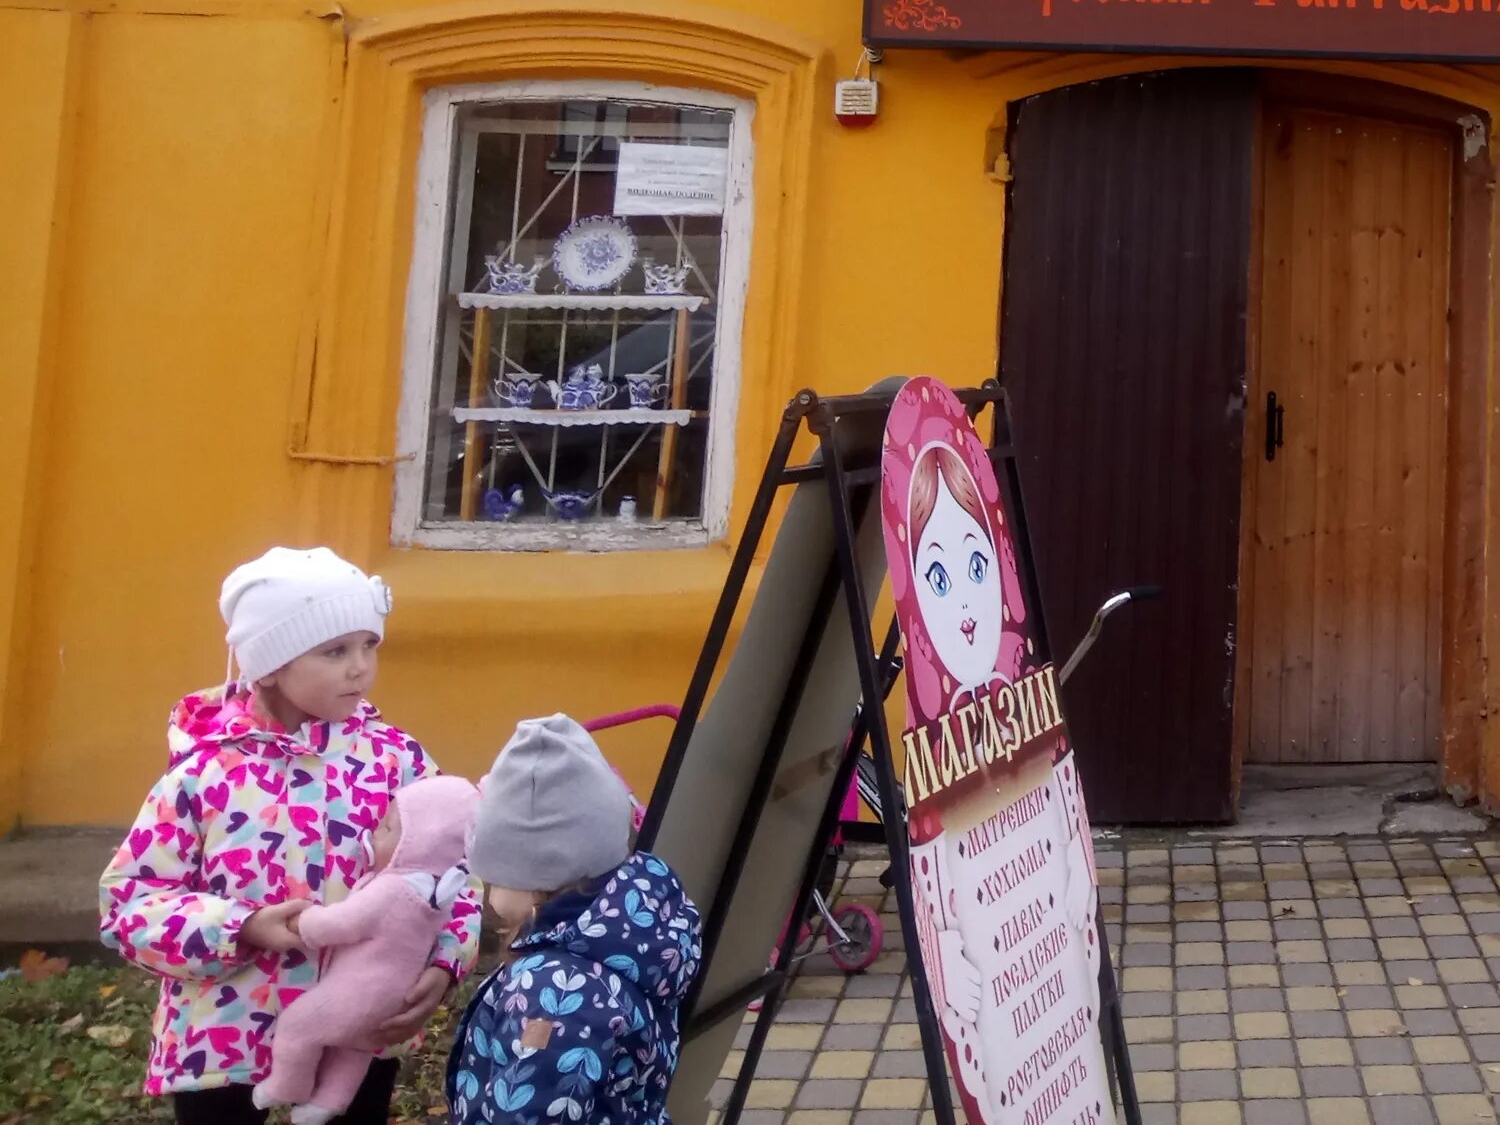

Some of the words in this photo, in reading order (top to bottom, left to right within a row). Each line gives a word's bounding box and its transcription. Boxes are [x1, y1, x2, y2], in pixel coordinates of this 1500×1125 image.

[902, 665, 1064, 809] МАГАЗИН
[966, 786, 1046, 860] МАТРЕШКИ
[982, 839, 1048, 906] ХОХЛОМА
[1000, 897, 1048, 953] ПАВЛО-
[991, 922, 1069, 1007] ПОСАДСКИЕ
[1011, 969, 1066, 1039] ПЛАТКИ
[1007, 1005, 1088, 1107] РОСТОВСКАЯ
